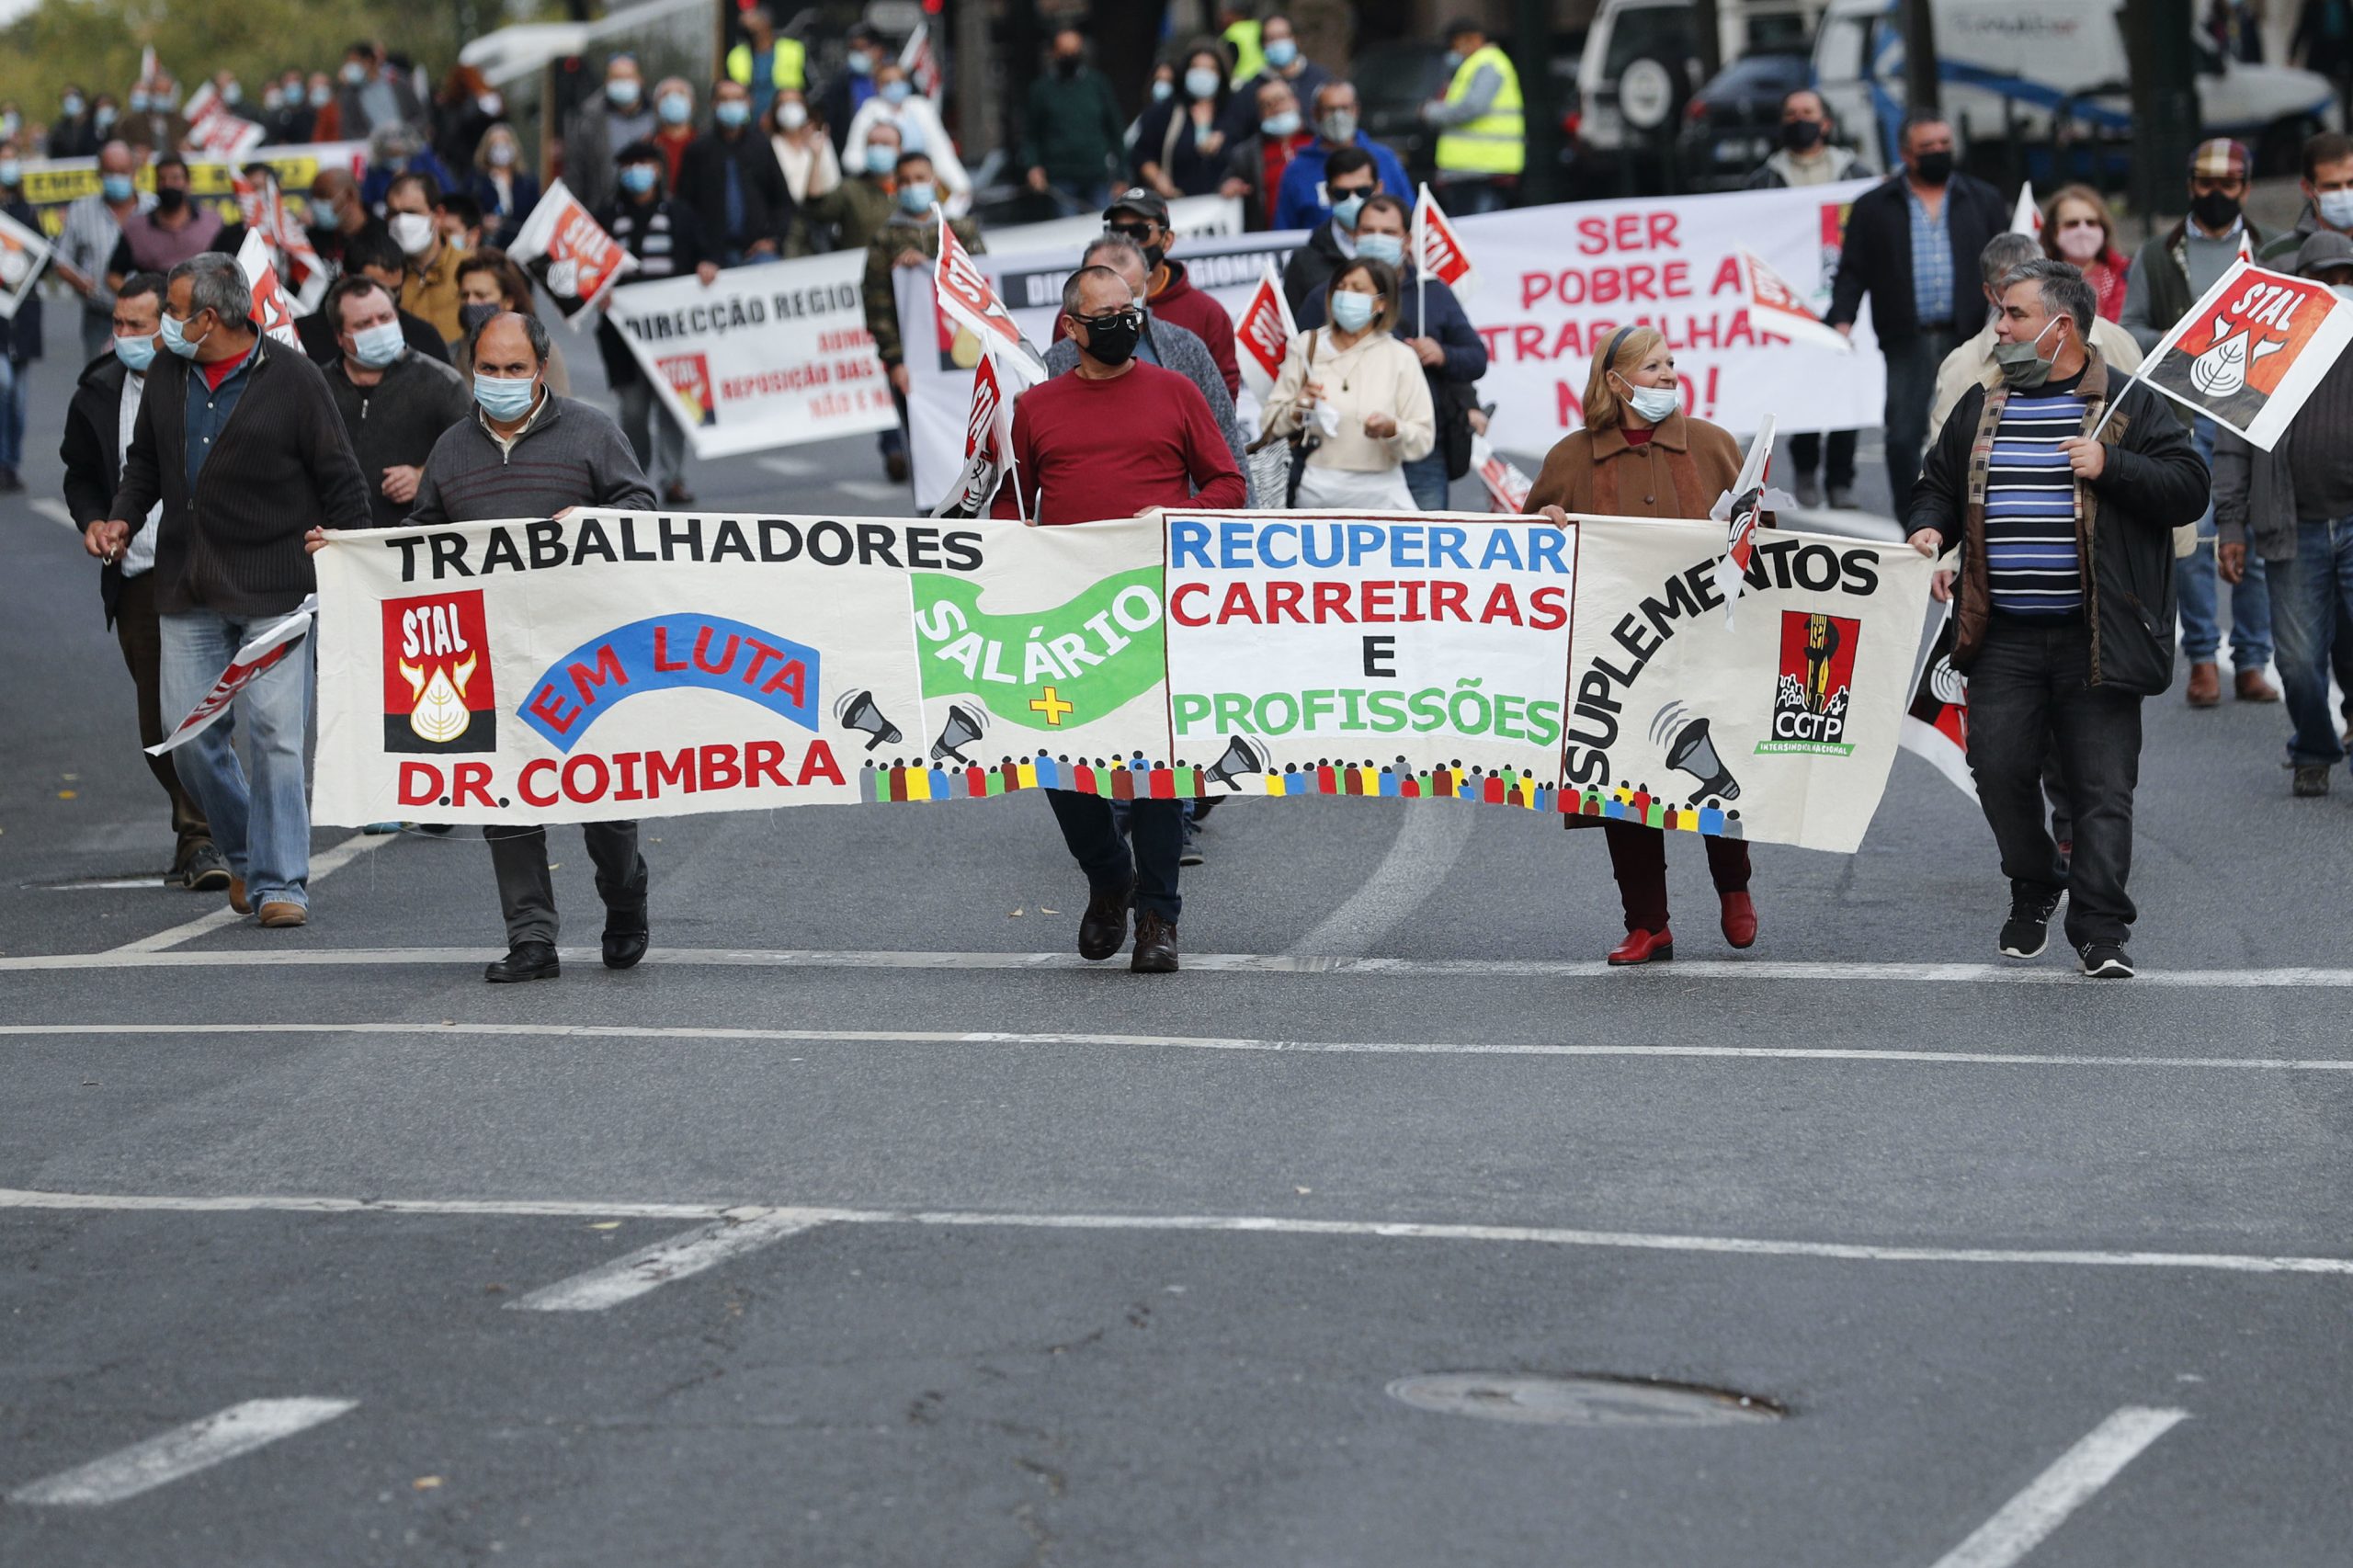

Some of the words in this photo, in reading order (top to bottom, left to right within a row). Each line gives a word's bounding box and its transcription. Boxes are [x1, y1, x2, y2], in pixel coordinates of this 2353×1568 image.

[1577, 211, 1680, 255] SER
[1520, 262, 1691, 311] POBRE
[1711, 256, 1742, 296] A
[2231, 281, 2306, 331] STAL
[385, 517, 983, 583] TRABALHADORES
[1171, 522, 1571, 574] RECUPERAR
[402, 602, 469, 659] STAL
[1169, 579, 1568, 631] CARREIRAS
[915, 584, 1163, 686] SALÁRIO
[1363, 635, 1396, 678] E
[529, 643, 630, 735] EM
[654, 624, 810, 710] LUTA
[1174, 676, 1561, 746] PROFISSÕES
[1775, 710, 1843, 742] CGTP
